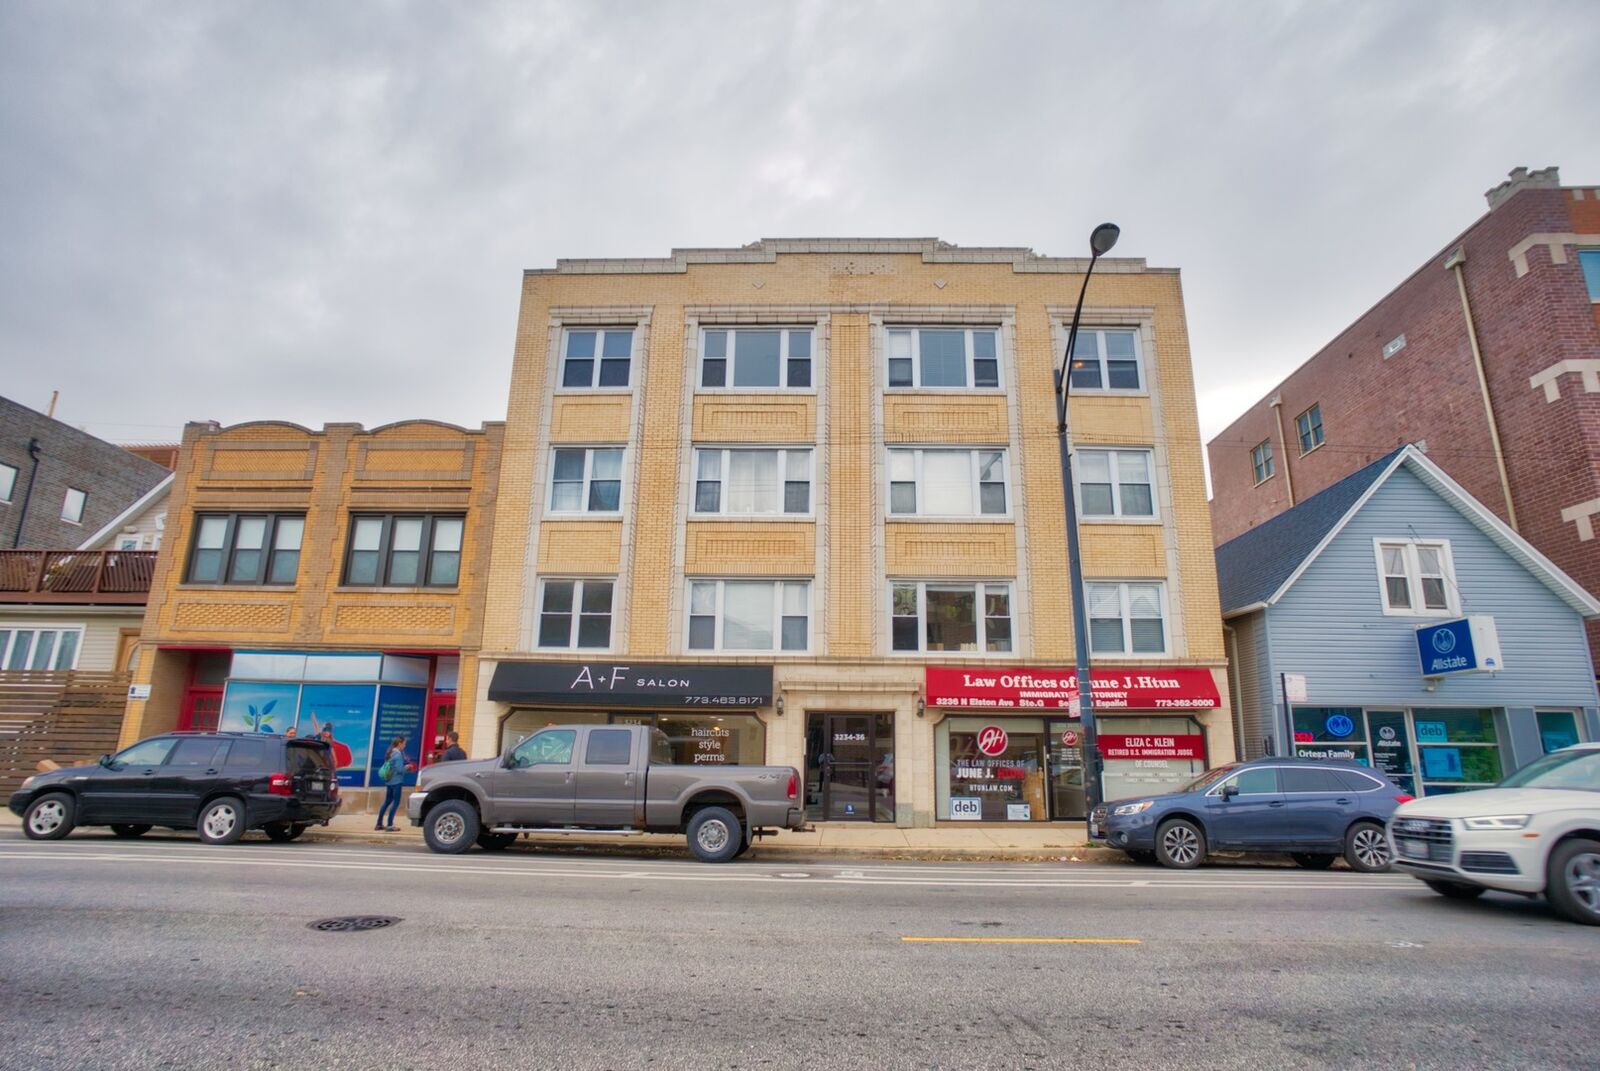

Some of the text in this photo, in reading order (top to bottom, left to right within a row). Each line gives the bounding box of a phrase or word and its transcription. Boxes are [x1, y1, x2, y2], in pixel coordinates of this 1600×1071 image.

[1431, 655, 1468, 671] Allstate
[636, 678, 690, 687] SALON
[963, 675, 997, 687] Law
[1000, 675, 1058, 688] Offices
[1060, 676, 1077, 688] of
[1090, 678, 1119, 688] une
[970, 698, 997, 706] Elston
[691, 727, 730, 737] haircuts
[1421, 725, 1443, 736] deb
[834, 733, 865, 741] 3234-36
[698, 740, 721, 750] style
[1125, 737, 1144, 747] ELIZA
[1154, 737, 1175, 748] KLEIN
[694, 752, 725, 763] perms
[1298, 749, 1355, 759] Ortega Family
[971, 759, 985, 767] LAW
[987, 759, 1014, 768] OFFICES
[956, 767, 982, 779] JUNE
[985, 767, 994, 779] J.
[954, 801, 977, 813] deb
